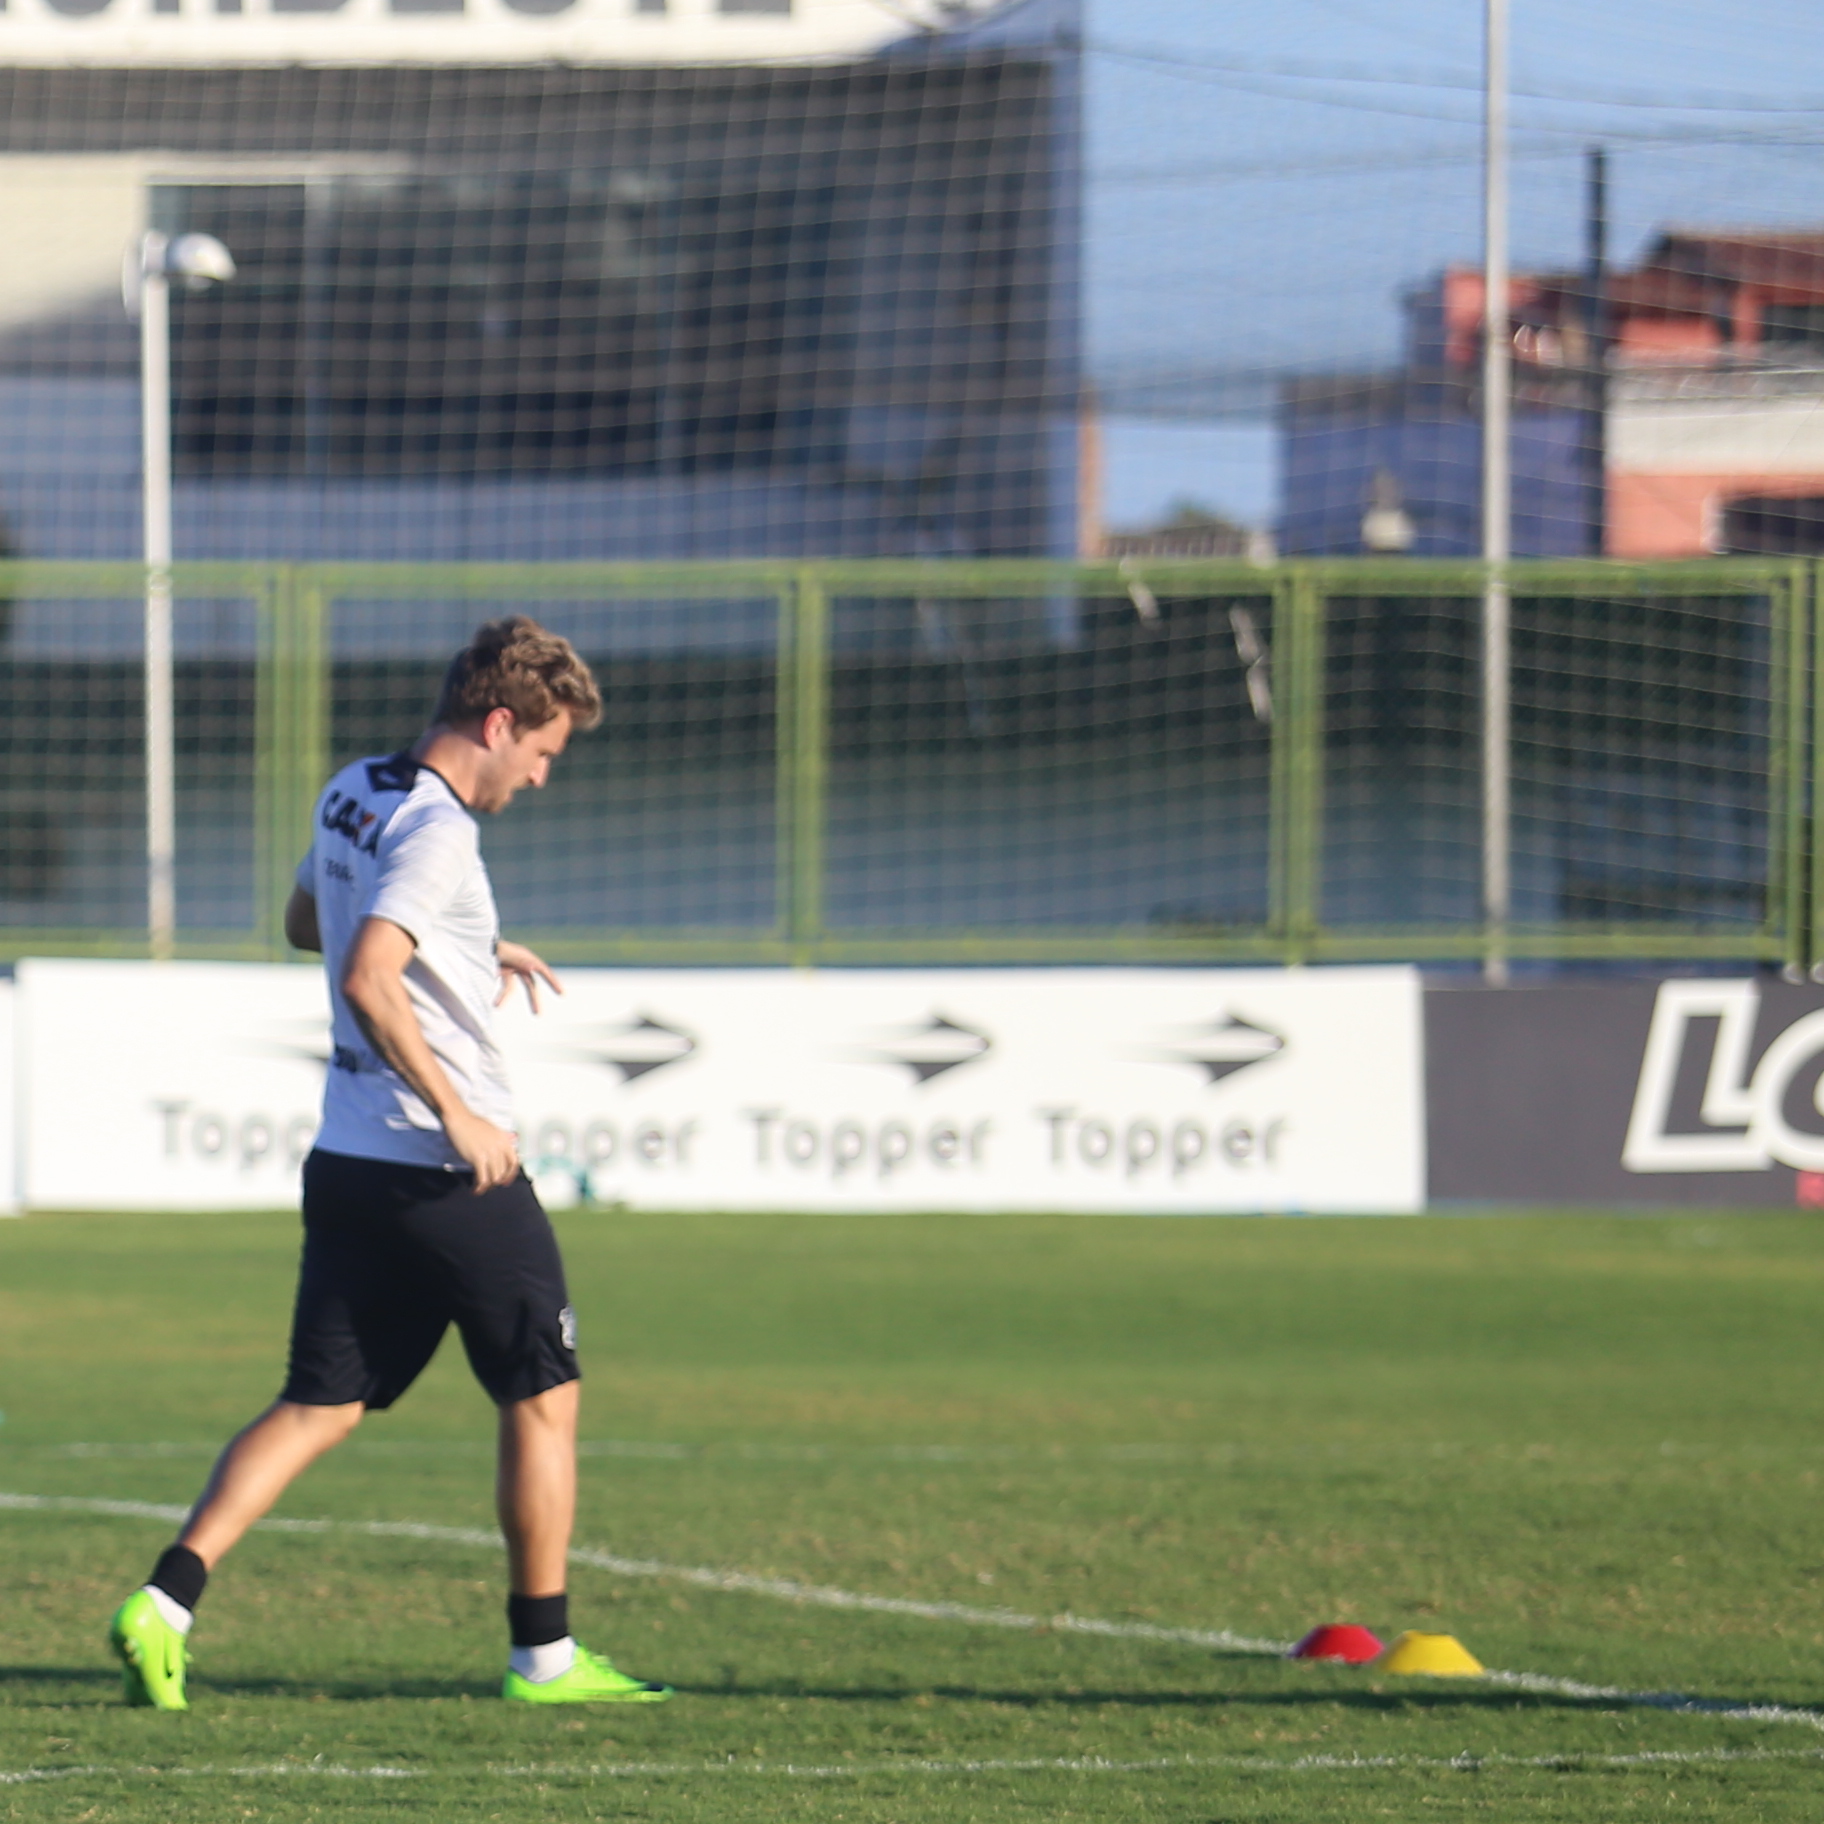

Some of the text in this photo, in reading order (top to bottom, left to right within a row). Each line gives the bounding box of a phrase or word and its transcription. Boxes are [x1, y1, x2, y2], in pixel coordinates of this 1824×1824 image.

[152, 1099, 319, 1172] Topp
[536, 1116, 707, 1172] pper
[740, 1104, 994, 1180] Topper
[1036, 1104, 1288, 1180] Topper
